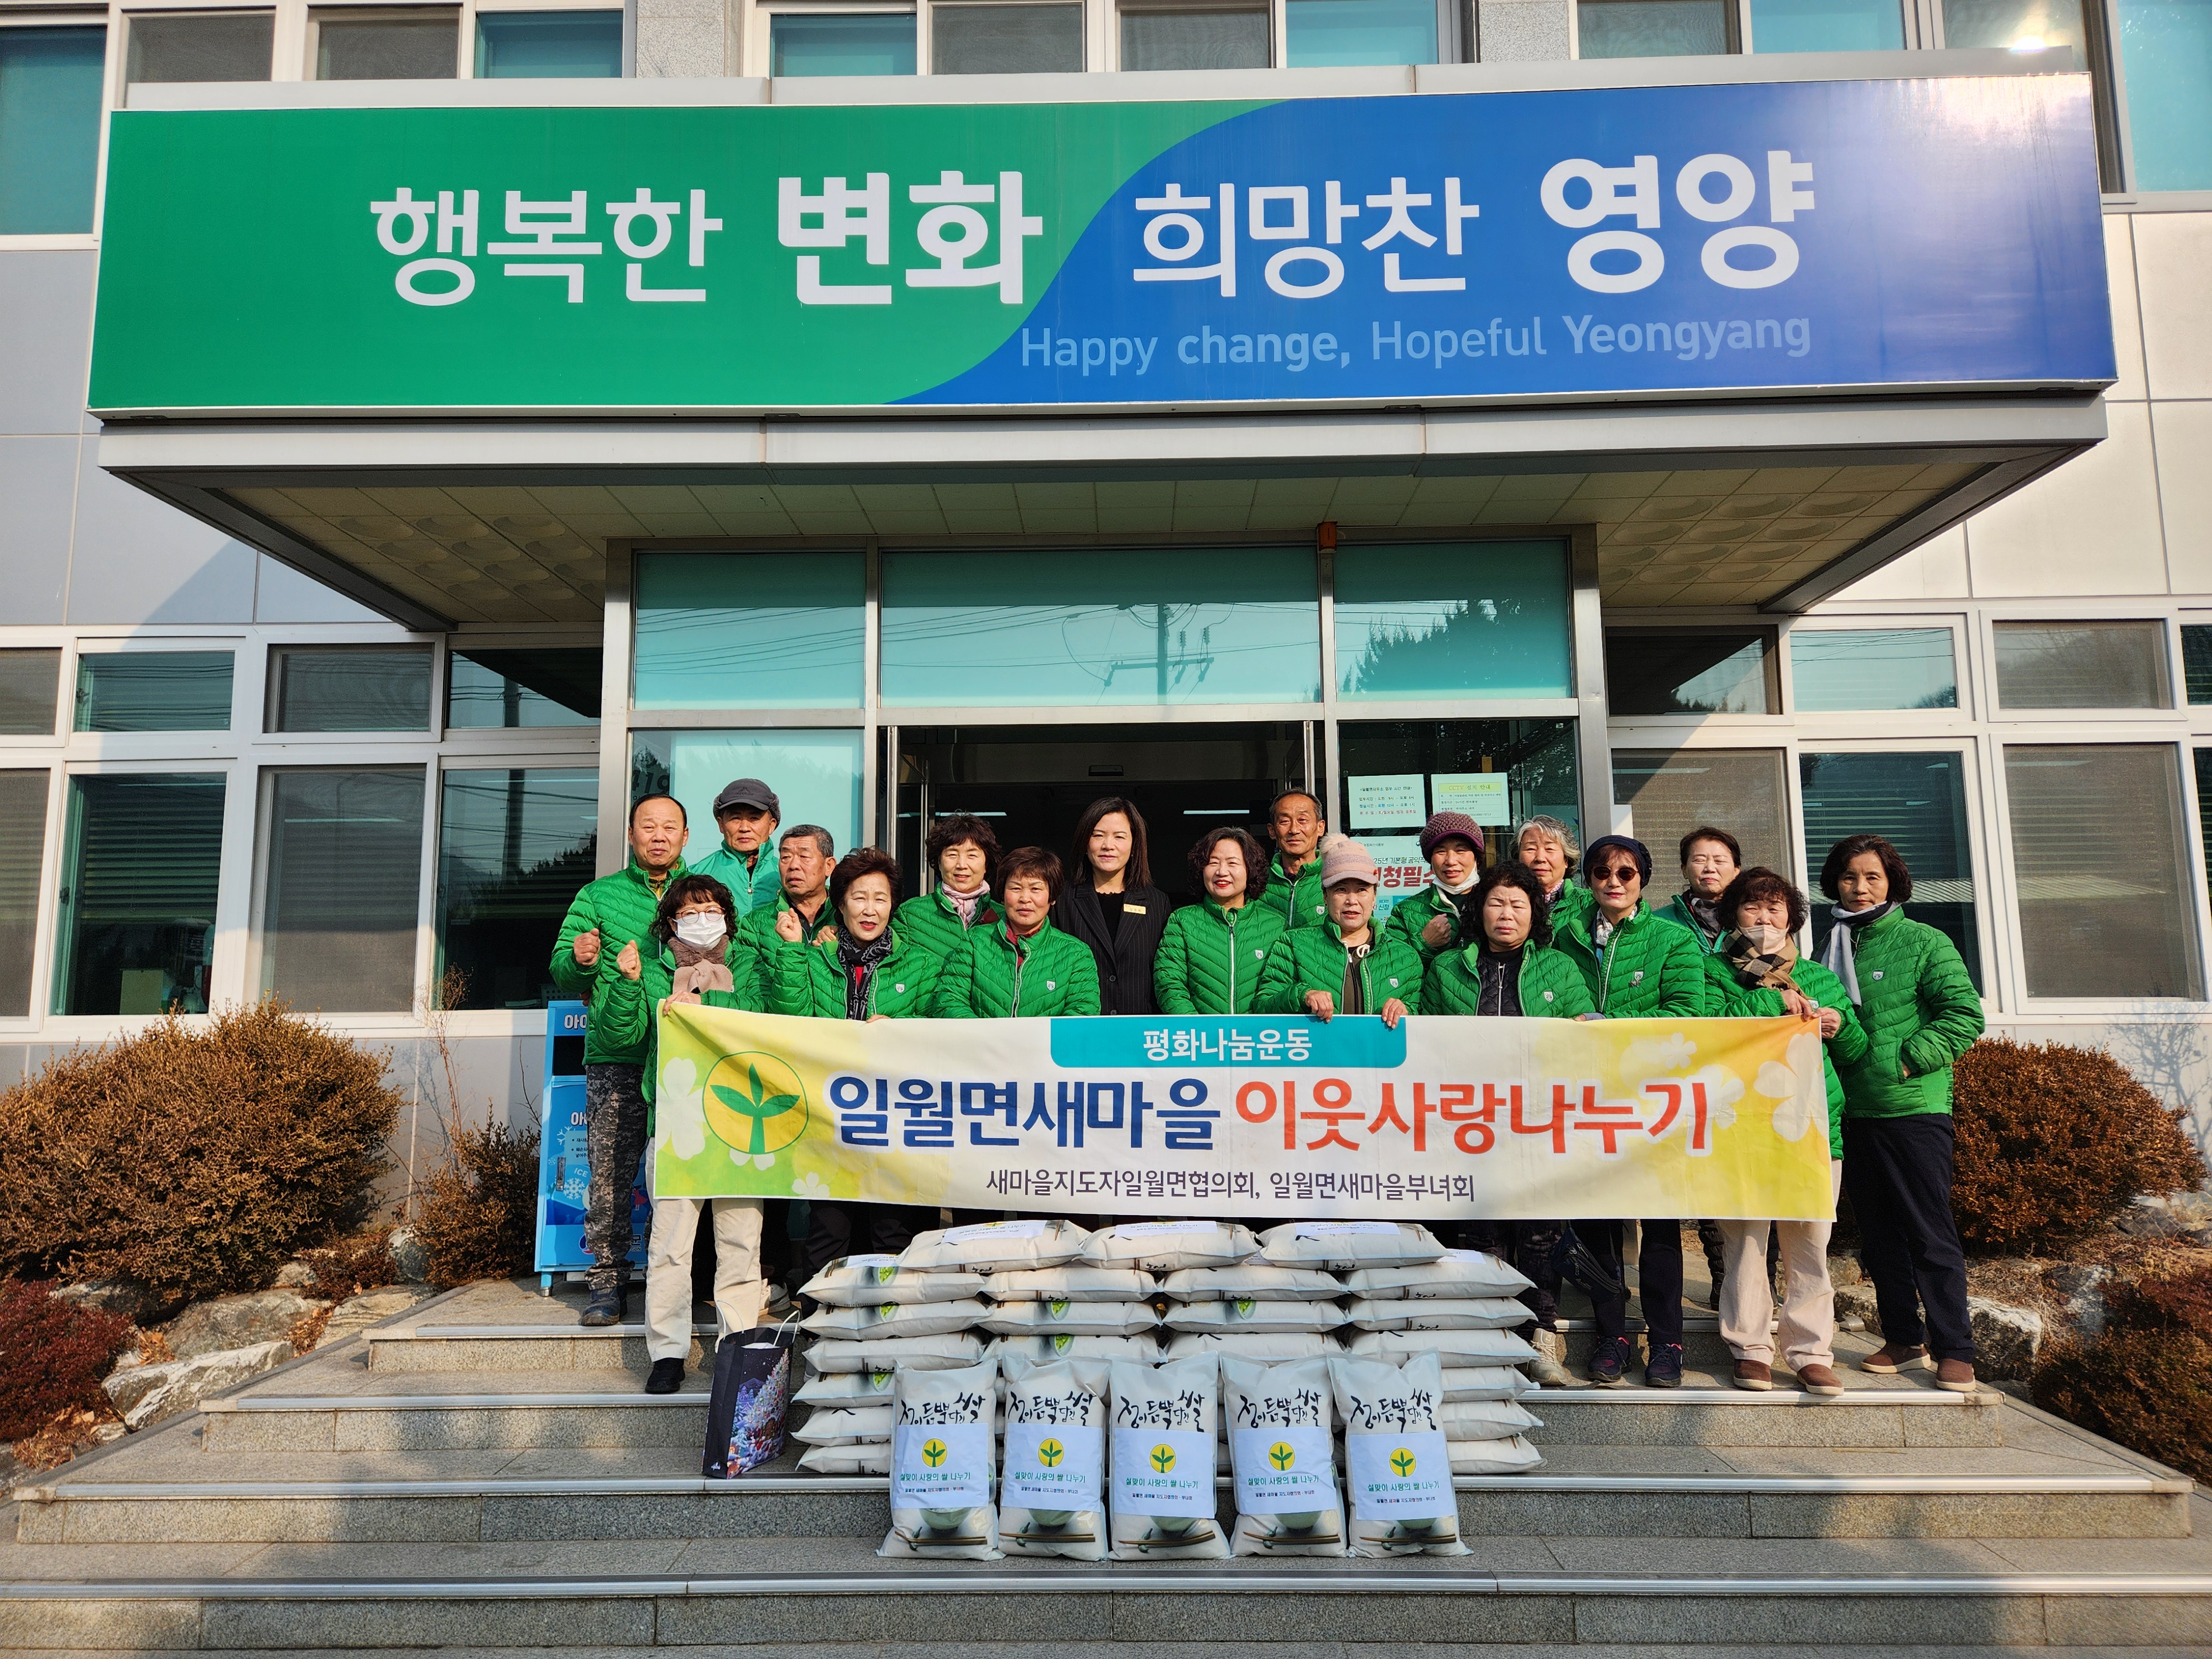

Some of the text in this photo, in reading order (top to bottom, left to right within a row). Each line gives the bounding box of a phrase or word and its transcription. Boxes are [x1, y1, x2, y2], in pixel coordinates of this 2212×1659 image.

[371, 150, 1815, 306] 행복한 변화 희망찬 영양
[1021, 314, 1812, 377] Happy change, Hopeful Yeongyang
[1377, 865, 1436, 888] 청필수
[1144, 1029, 1312, 1061] 평화나눔운동
[831, 1076, 1707, 1154] 일월면새마을 이웃사랑나누기
[574, 1167, 588, 1177] ICE
[987, 1169, 1475, 1202] 새마을지도자일월면협의회, 일월면새마을부녀회
[1063, 1391, 1097, 1426] 쌀
[1177, 1389, 1205, 1432] 쌀
[1295, 1388, 1322, 1427] 쌀
[1410, 1388, 1436, 1431] 쌀
[900, 1472, 971, 1481] 설맞이 사랑의 쌀 나누기
[1015, 1472, 1033, 1480] 설맞이
[1035, 1472, 1054, 1481] 사랑의
[1066, 1474, 1086, 1483] 나누기
[1125, 1477, 1145, 1486] 설맞이
[1147, 1479, 1167, 1487] 사랑의
[1179, 1480, 1198, 1489] 나누기
[1248, 1478, 1266, 1486] 설맞이
[1269, 1477, 1289, 1485] 사랑의
[1300, 1475, 1319, 1483] 나누기
[1368, 1480, 1439, 1491] 설맞이 사랑의 쌀 나누기
